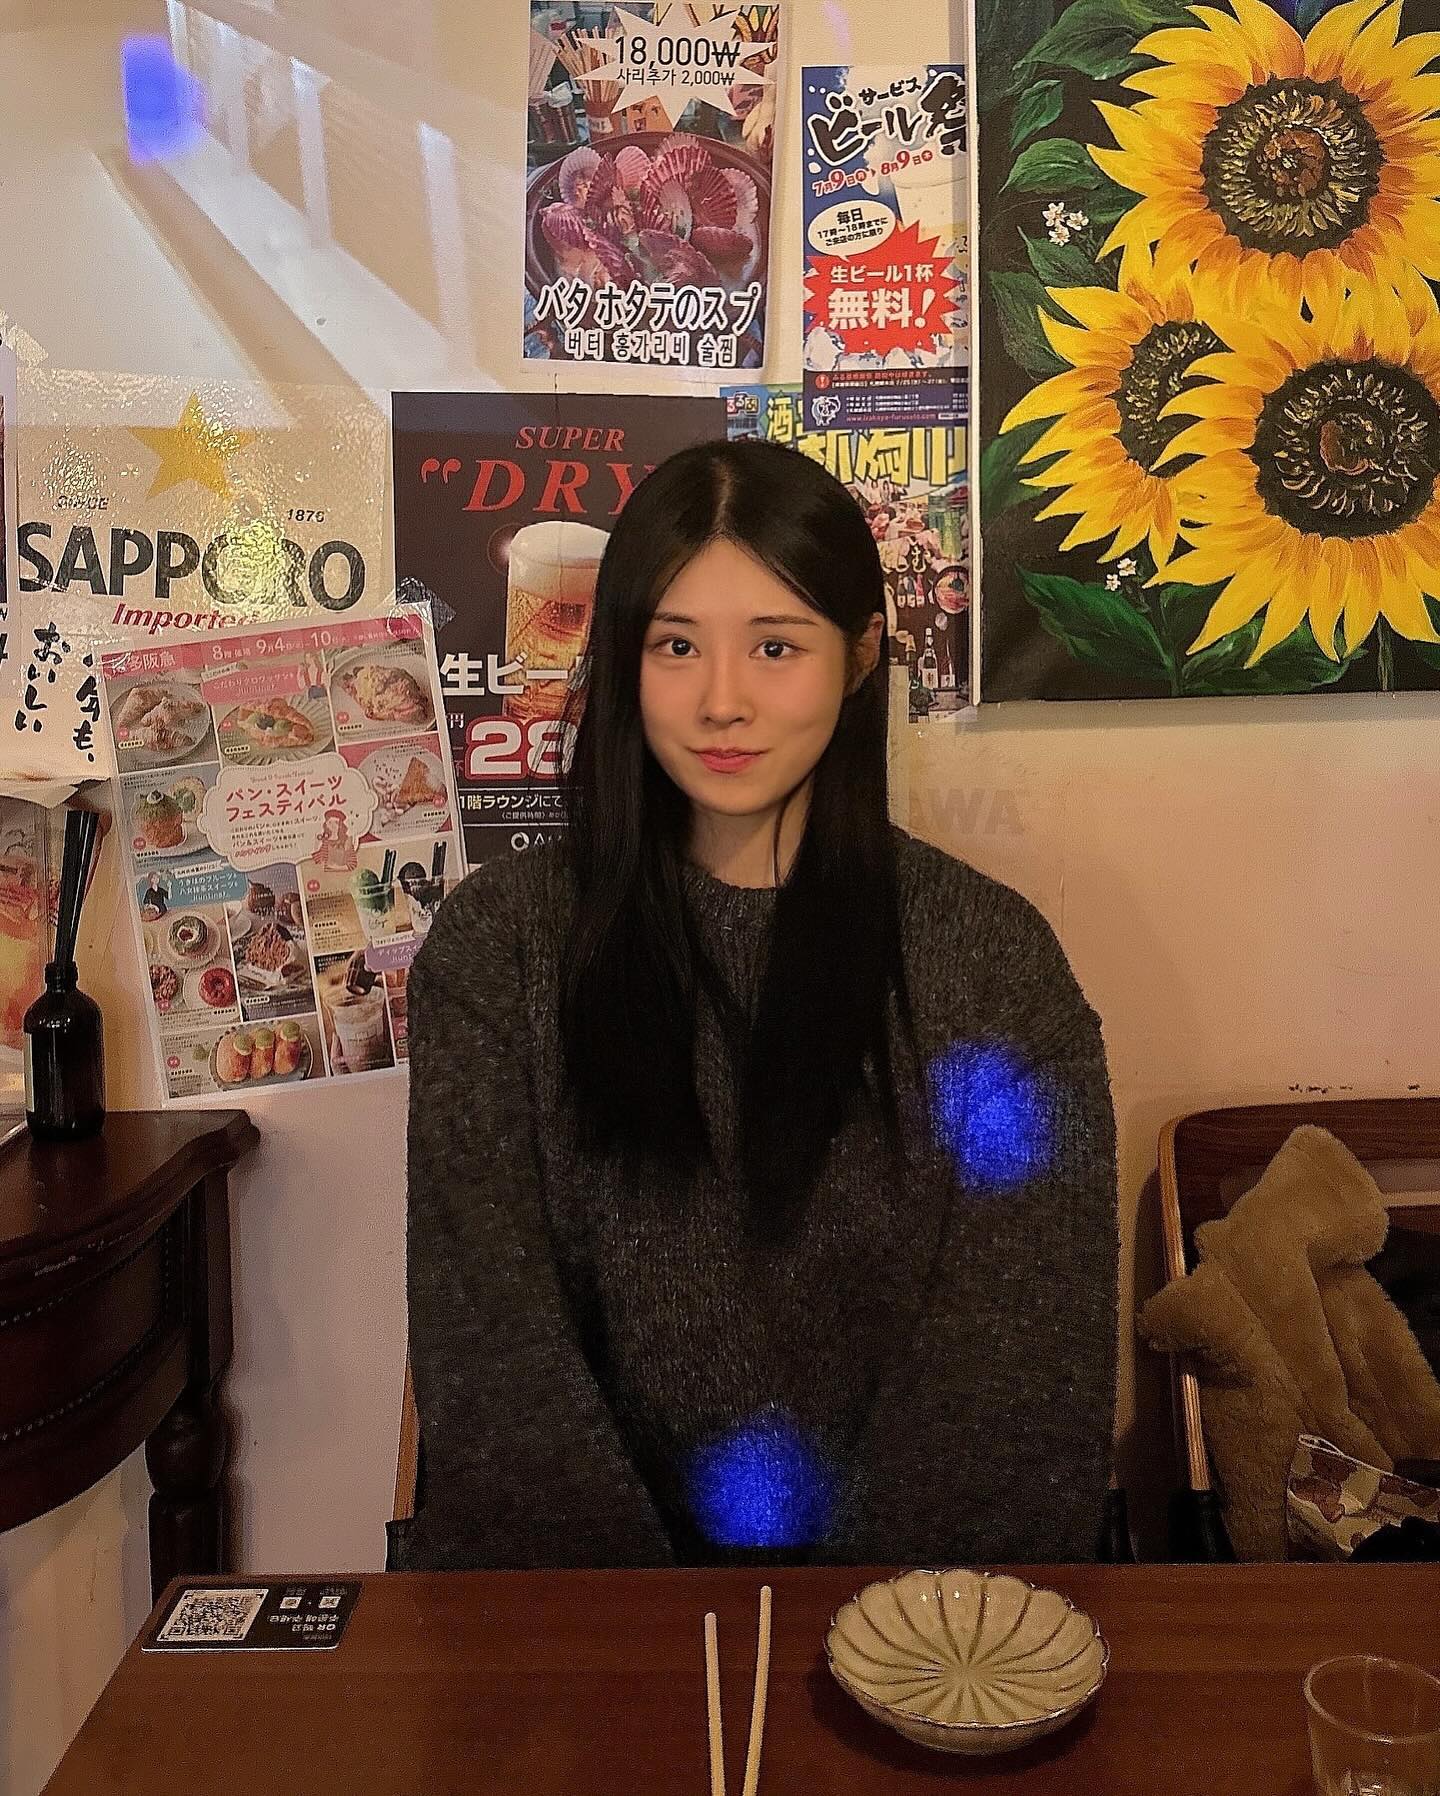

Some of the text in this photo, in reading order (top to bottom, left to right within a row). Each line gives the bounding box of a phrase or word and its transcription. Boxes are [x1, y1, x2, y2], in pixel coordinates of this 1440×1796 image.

[616, 68, 677, 87] 사리추가
[858, 77, 922, 105] サービス
[836, 207, 864, 225] 毎日
[830, 263, 935, 285] 生ビール1杯
[565, 328, 738, 367] 버터 홍가리비 술찜
[515, 425, 626, 452] SUPER
[226, 774, 344, 803] パン・スイーツ
[226, 793, 347, 823] フェスティバル
[316, 1623, 337, 1631] QR
